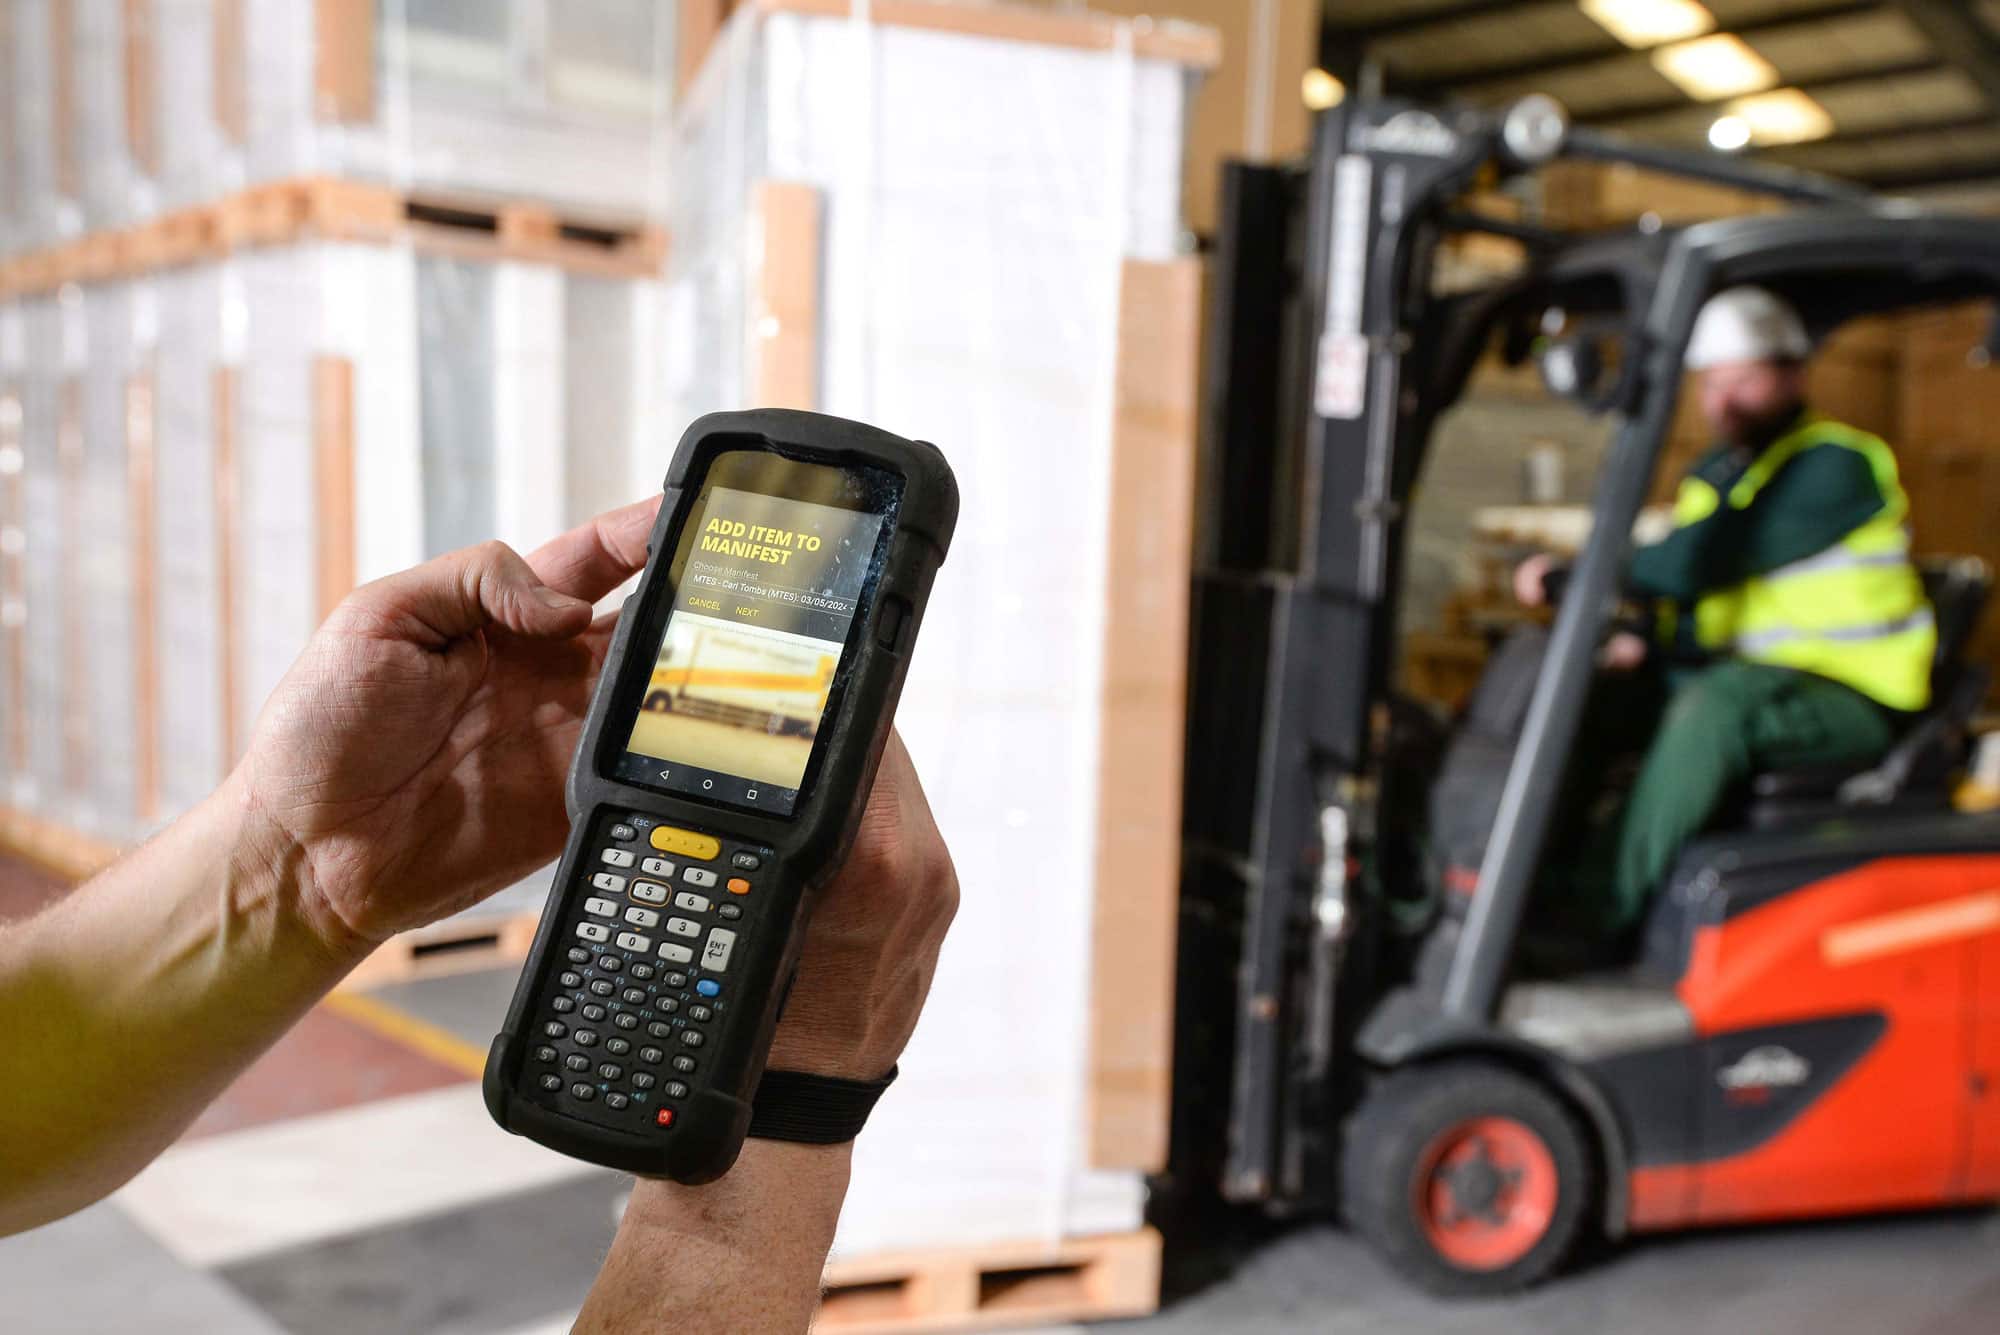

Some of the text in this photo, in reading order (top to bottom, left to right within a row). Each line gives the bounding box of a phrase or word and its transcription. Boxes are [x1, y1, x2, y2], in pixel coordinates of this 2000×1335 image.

[706, 518, 820, 551] ADD ITEM TO
[700, 536, 792, 565] MANIFEST
[722, 567, 758, 580] Manifest
[694, 574, 718, 585] MTES
[722, 580, 738, 590] Carl
[741, 583, 766, 595] Tombs
[768, 588, 800, 602] (MTES):
[688, 597, 720, 610] CANCEL
[736, 606, 760, 616] NEXT
[616, 826, 628, 836] P1
[614, 852, 621, 860] 7
[740, 856, 752, 865] P2
[654, 862, 660, 871] 8
[696, 872, 703, 881] 9
[604, 878, 612, 886] 4
[646, 886, 653, 896] 5
[688, 897, 694, 906] 6
[598, 903, 604, 911] 1
[637, 912, 644, 922] 2
[679, 922, 686, 932] 3
[629, 937, 636, 946] 0
[710, 941, 726, 950] ENT
[592, 944, 606, 953] ALT
[624, 952, 632, 960] F1
[604, 960, 612, 969] A
[656, 960, 664, 968] F2
[584, 968, 592, 976] F4
[638, 967, 645, 976] B
[567, 974, 574, 984] D
[670, 974, 678, 984] C
[598, 984, 606, 993] E
[648, 984, 656, 992] F6
[630, 992, 637, 1000] F
[558, 1000, 564, 1008] I
[663, 1000, 670, 1010] G
[590, 1008, 596, 1018] J
[696, 1009, 704, 1018] H
[621, 1016, 630, 1027] K
[550, 1025, 558, 1034] N
[654, 1025, 661, 1034] L
[686, 1032, 696, 1044] M
[614, 1042, 620, 1052] P
[542, 1050, 549, 1060] S
[573, 1059, 582, 1068] T
[680, 1060, 688, 1070] R
[606, 1068, 614, 1078] U
[544, 1078, 554, 1088] X
[639, 1076, 648, 1086] V
[578, 1086, 586, 1097] Y
[671, 1086, 682, 1096] W
[612, 1096, 620, 1106] Z
